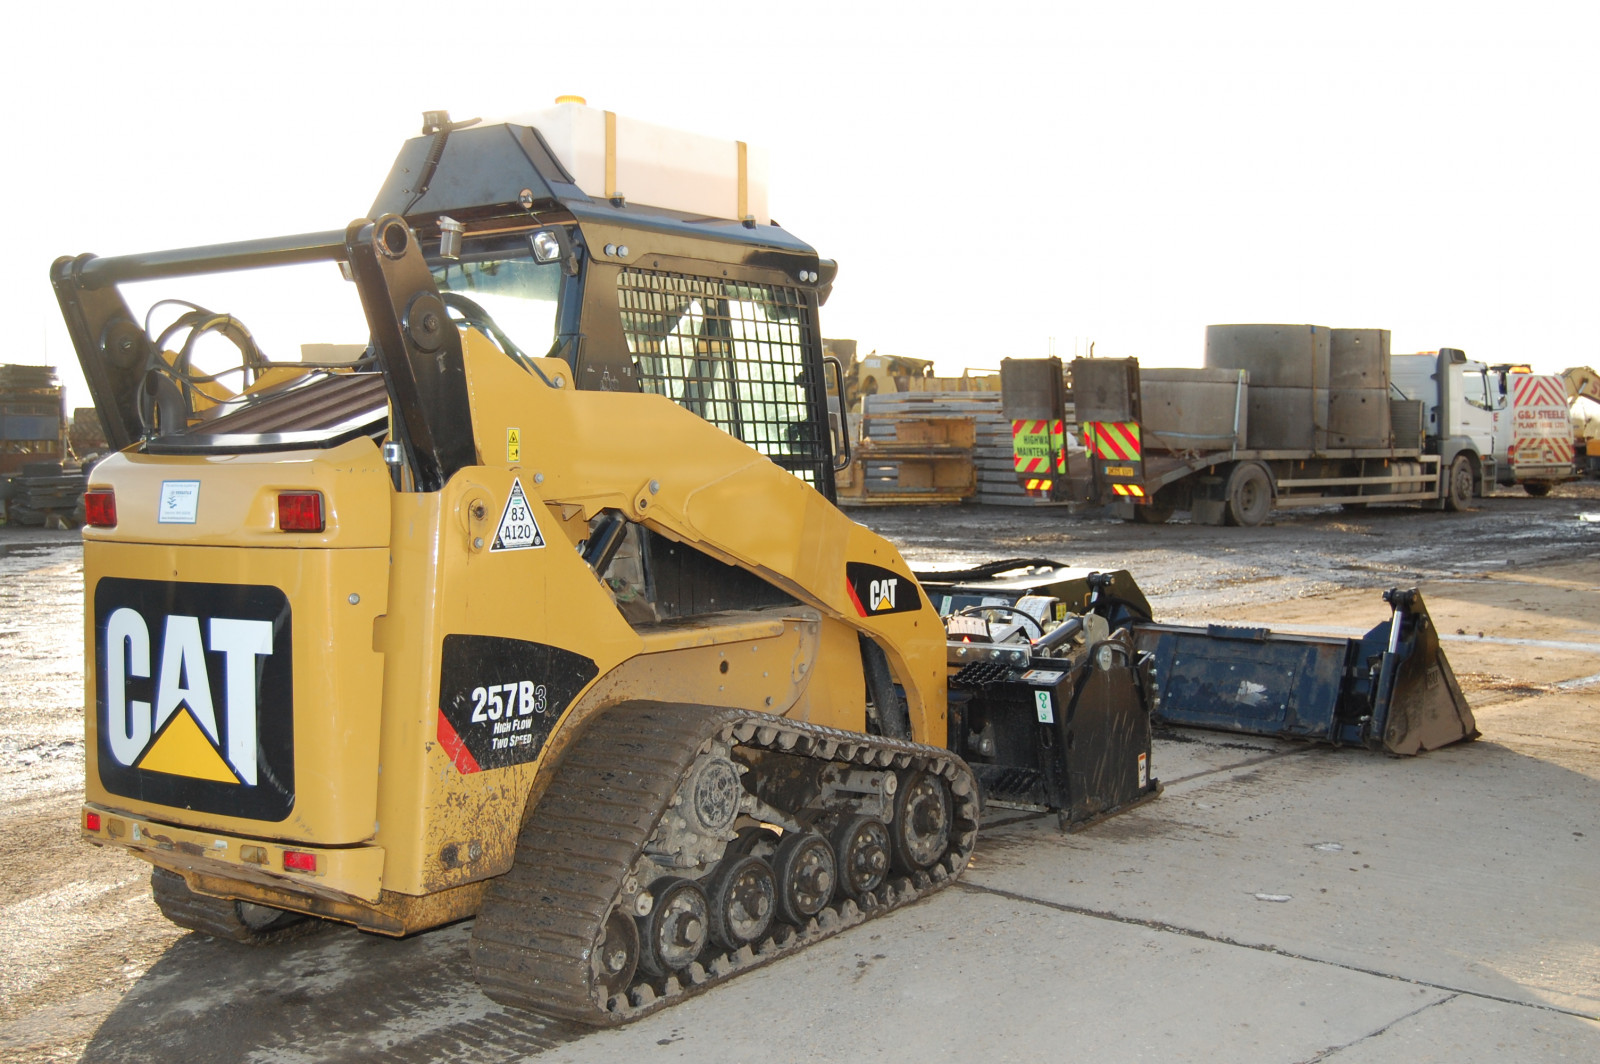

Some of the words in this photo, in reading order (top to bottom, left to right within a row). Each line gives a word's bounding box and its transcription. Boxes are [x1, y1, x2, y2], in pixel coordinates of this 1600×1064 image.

[1517, 410, 1536, 420] G&J
[1538, 410, 1566, 420] STEELE
[511, 507, 525, 521] 83
[869, 578, 898, 611] CAT
[107, 607, 273, 786] CAT
[471, 680, 547, 723] 257B3
